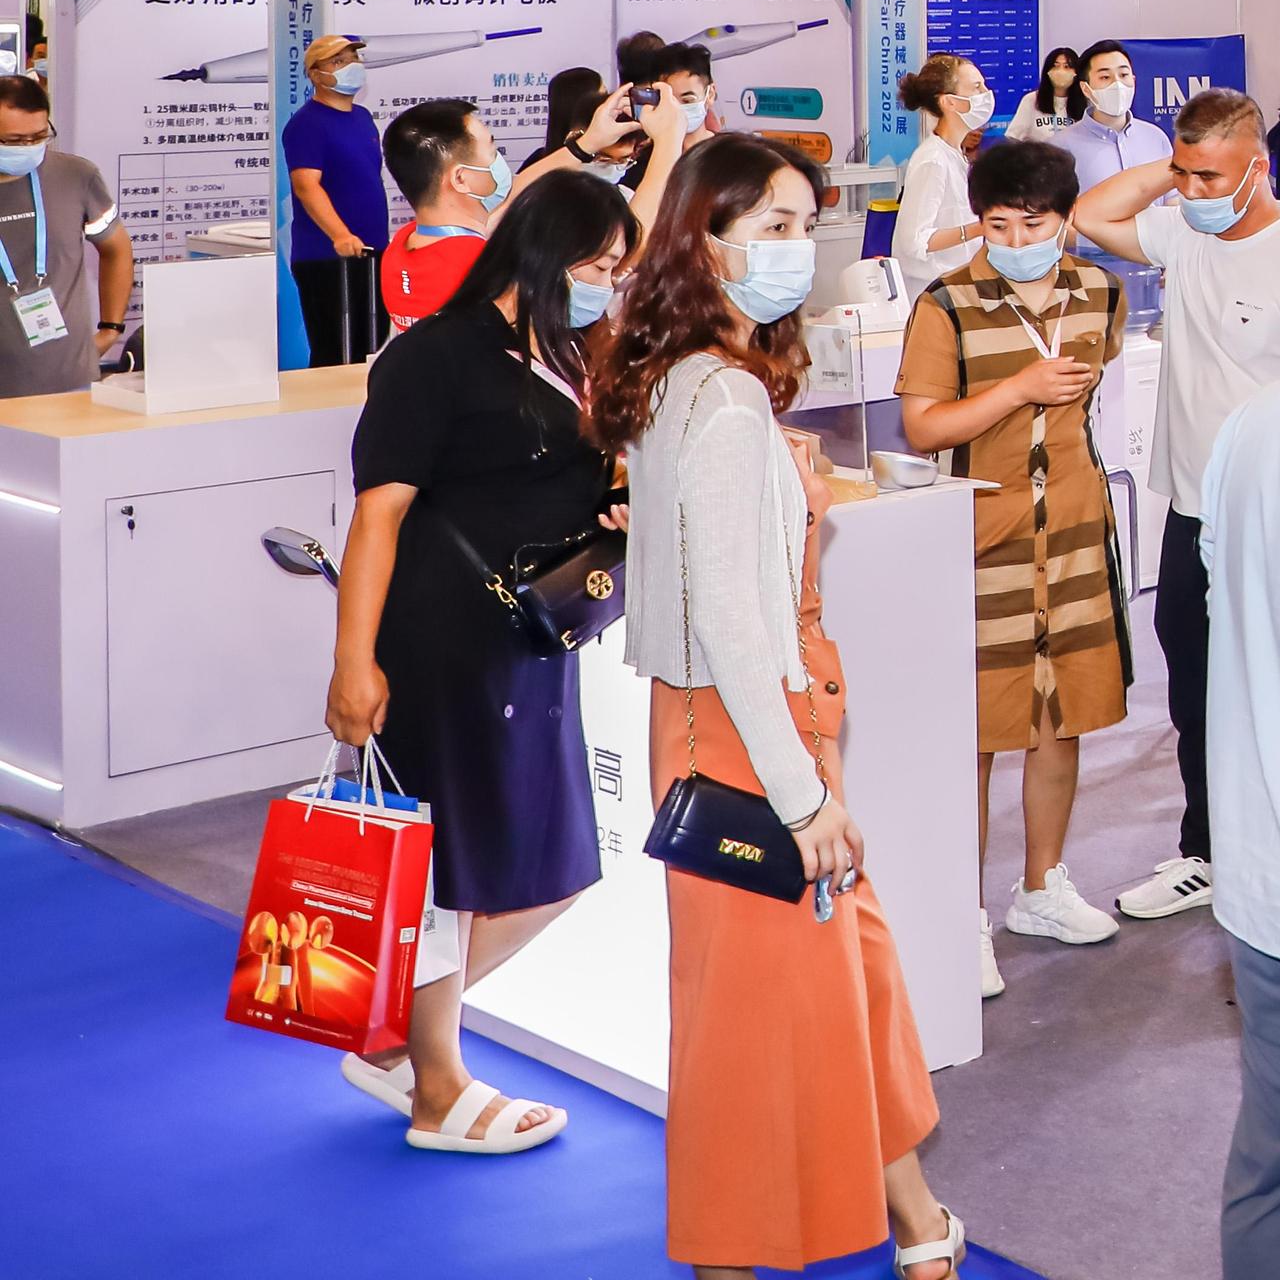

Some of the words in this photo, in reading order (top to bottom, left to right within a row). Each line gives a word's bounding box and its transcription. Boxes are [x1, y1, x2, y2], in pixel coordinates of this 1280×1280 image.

[289, 47, 299, 105] China
[881, 36, 891, 85] China
[882, 92, 891, 133] 2022
